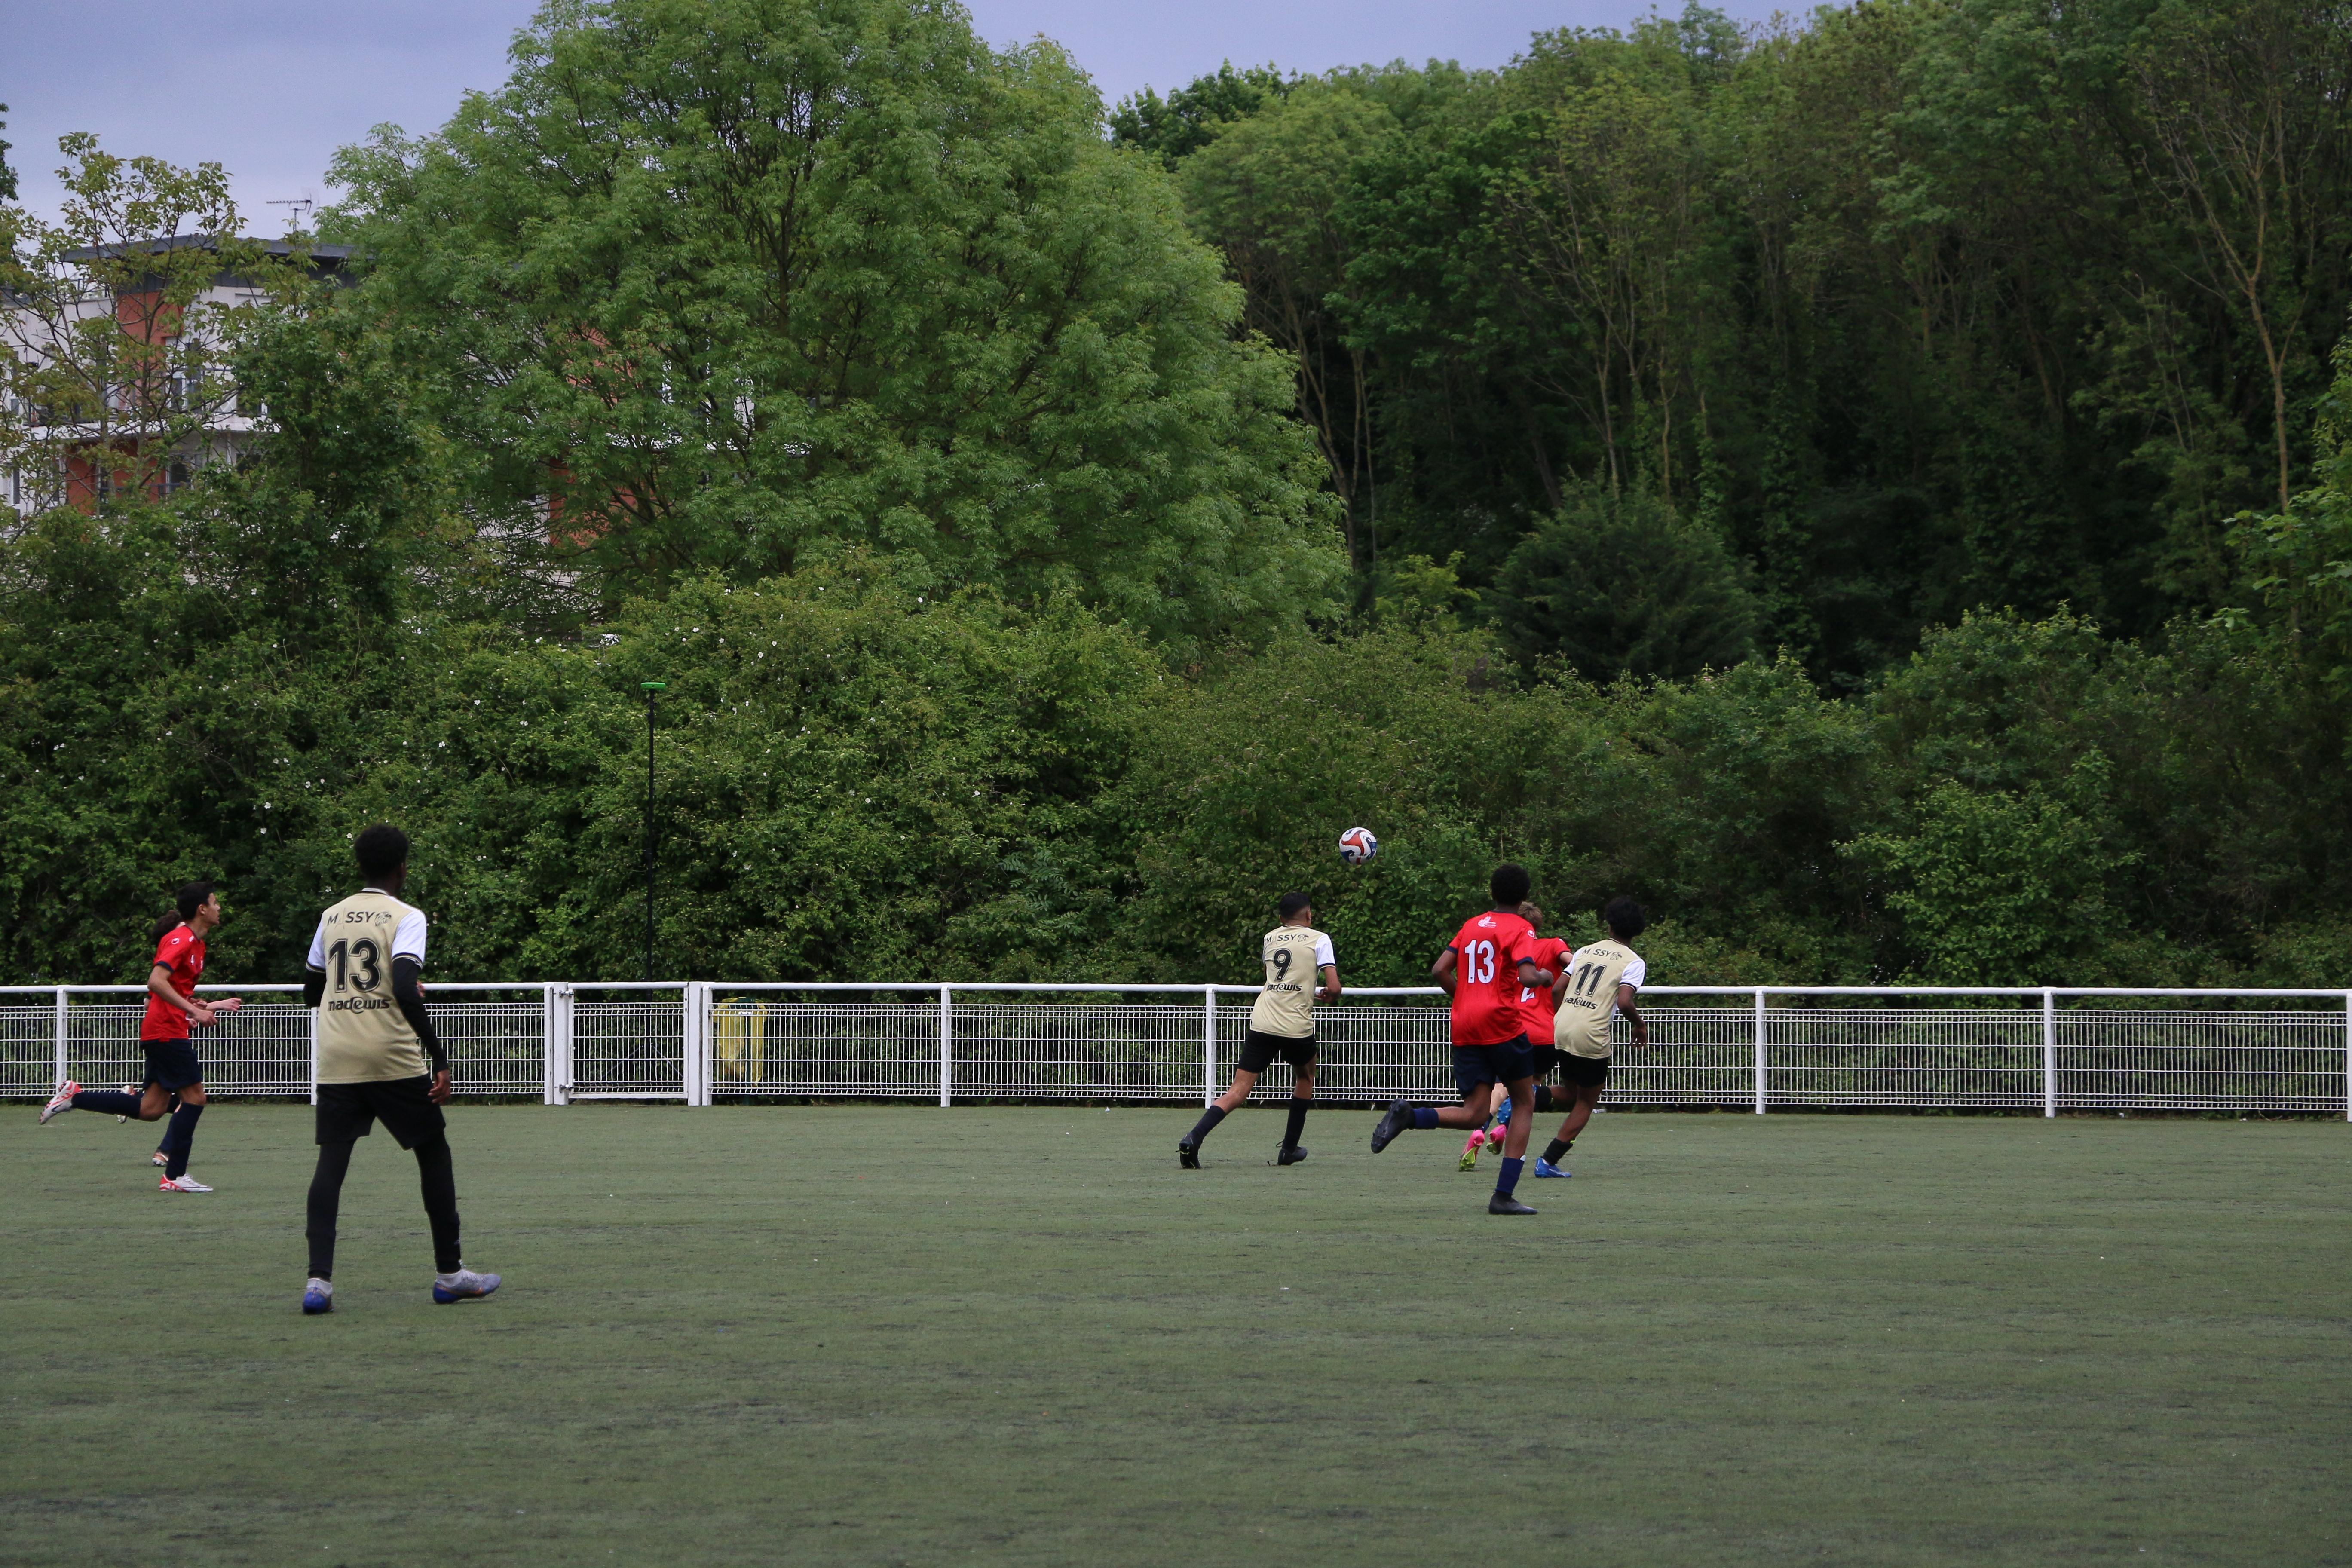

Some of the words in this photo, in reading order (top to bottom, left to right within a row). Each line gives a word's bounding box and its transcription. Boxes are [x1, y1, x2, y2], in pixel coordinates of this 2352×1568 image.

[328, 938, 381, 993] 13
[1273, 948, 1292, 982] 9
[1464, 939, 1494, 984] 13
[1575, 962, 1607, 998] 11
